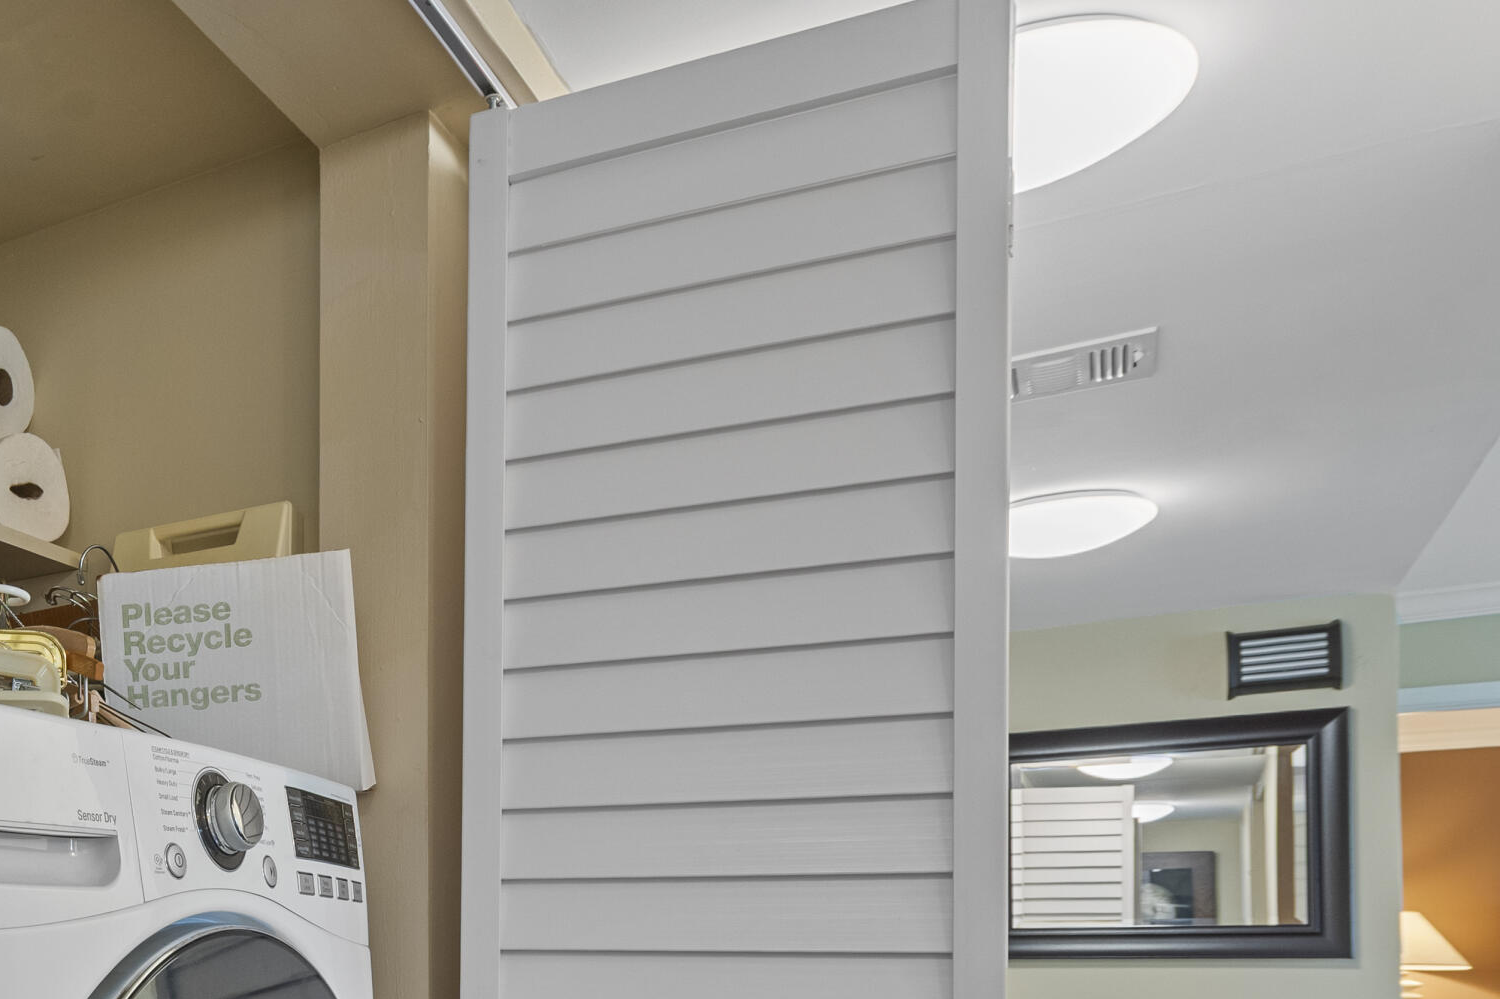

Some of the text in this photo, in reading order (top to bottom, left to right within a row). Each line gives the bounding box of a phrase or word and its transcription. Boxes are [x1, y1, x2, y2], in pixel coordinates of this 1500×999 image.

[121, 601, 231, 628] Please
[123, 623, 253, 657] Recycle
[123, 658, 196, 682] Your
[127, 682, 263, 711] Hangers
[77, 808, 117, 825] Sensor Dry
